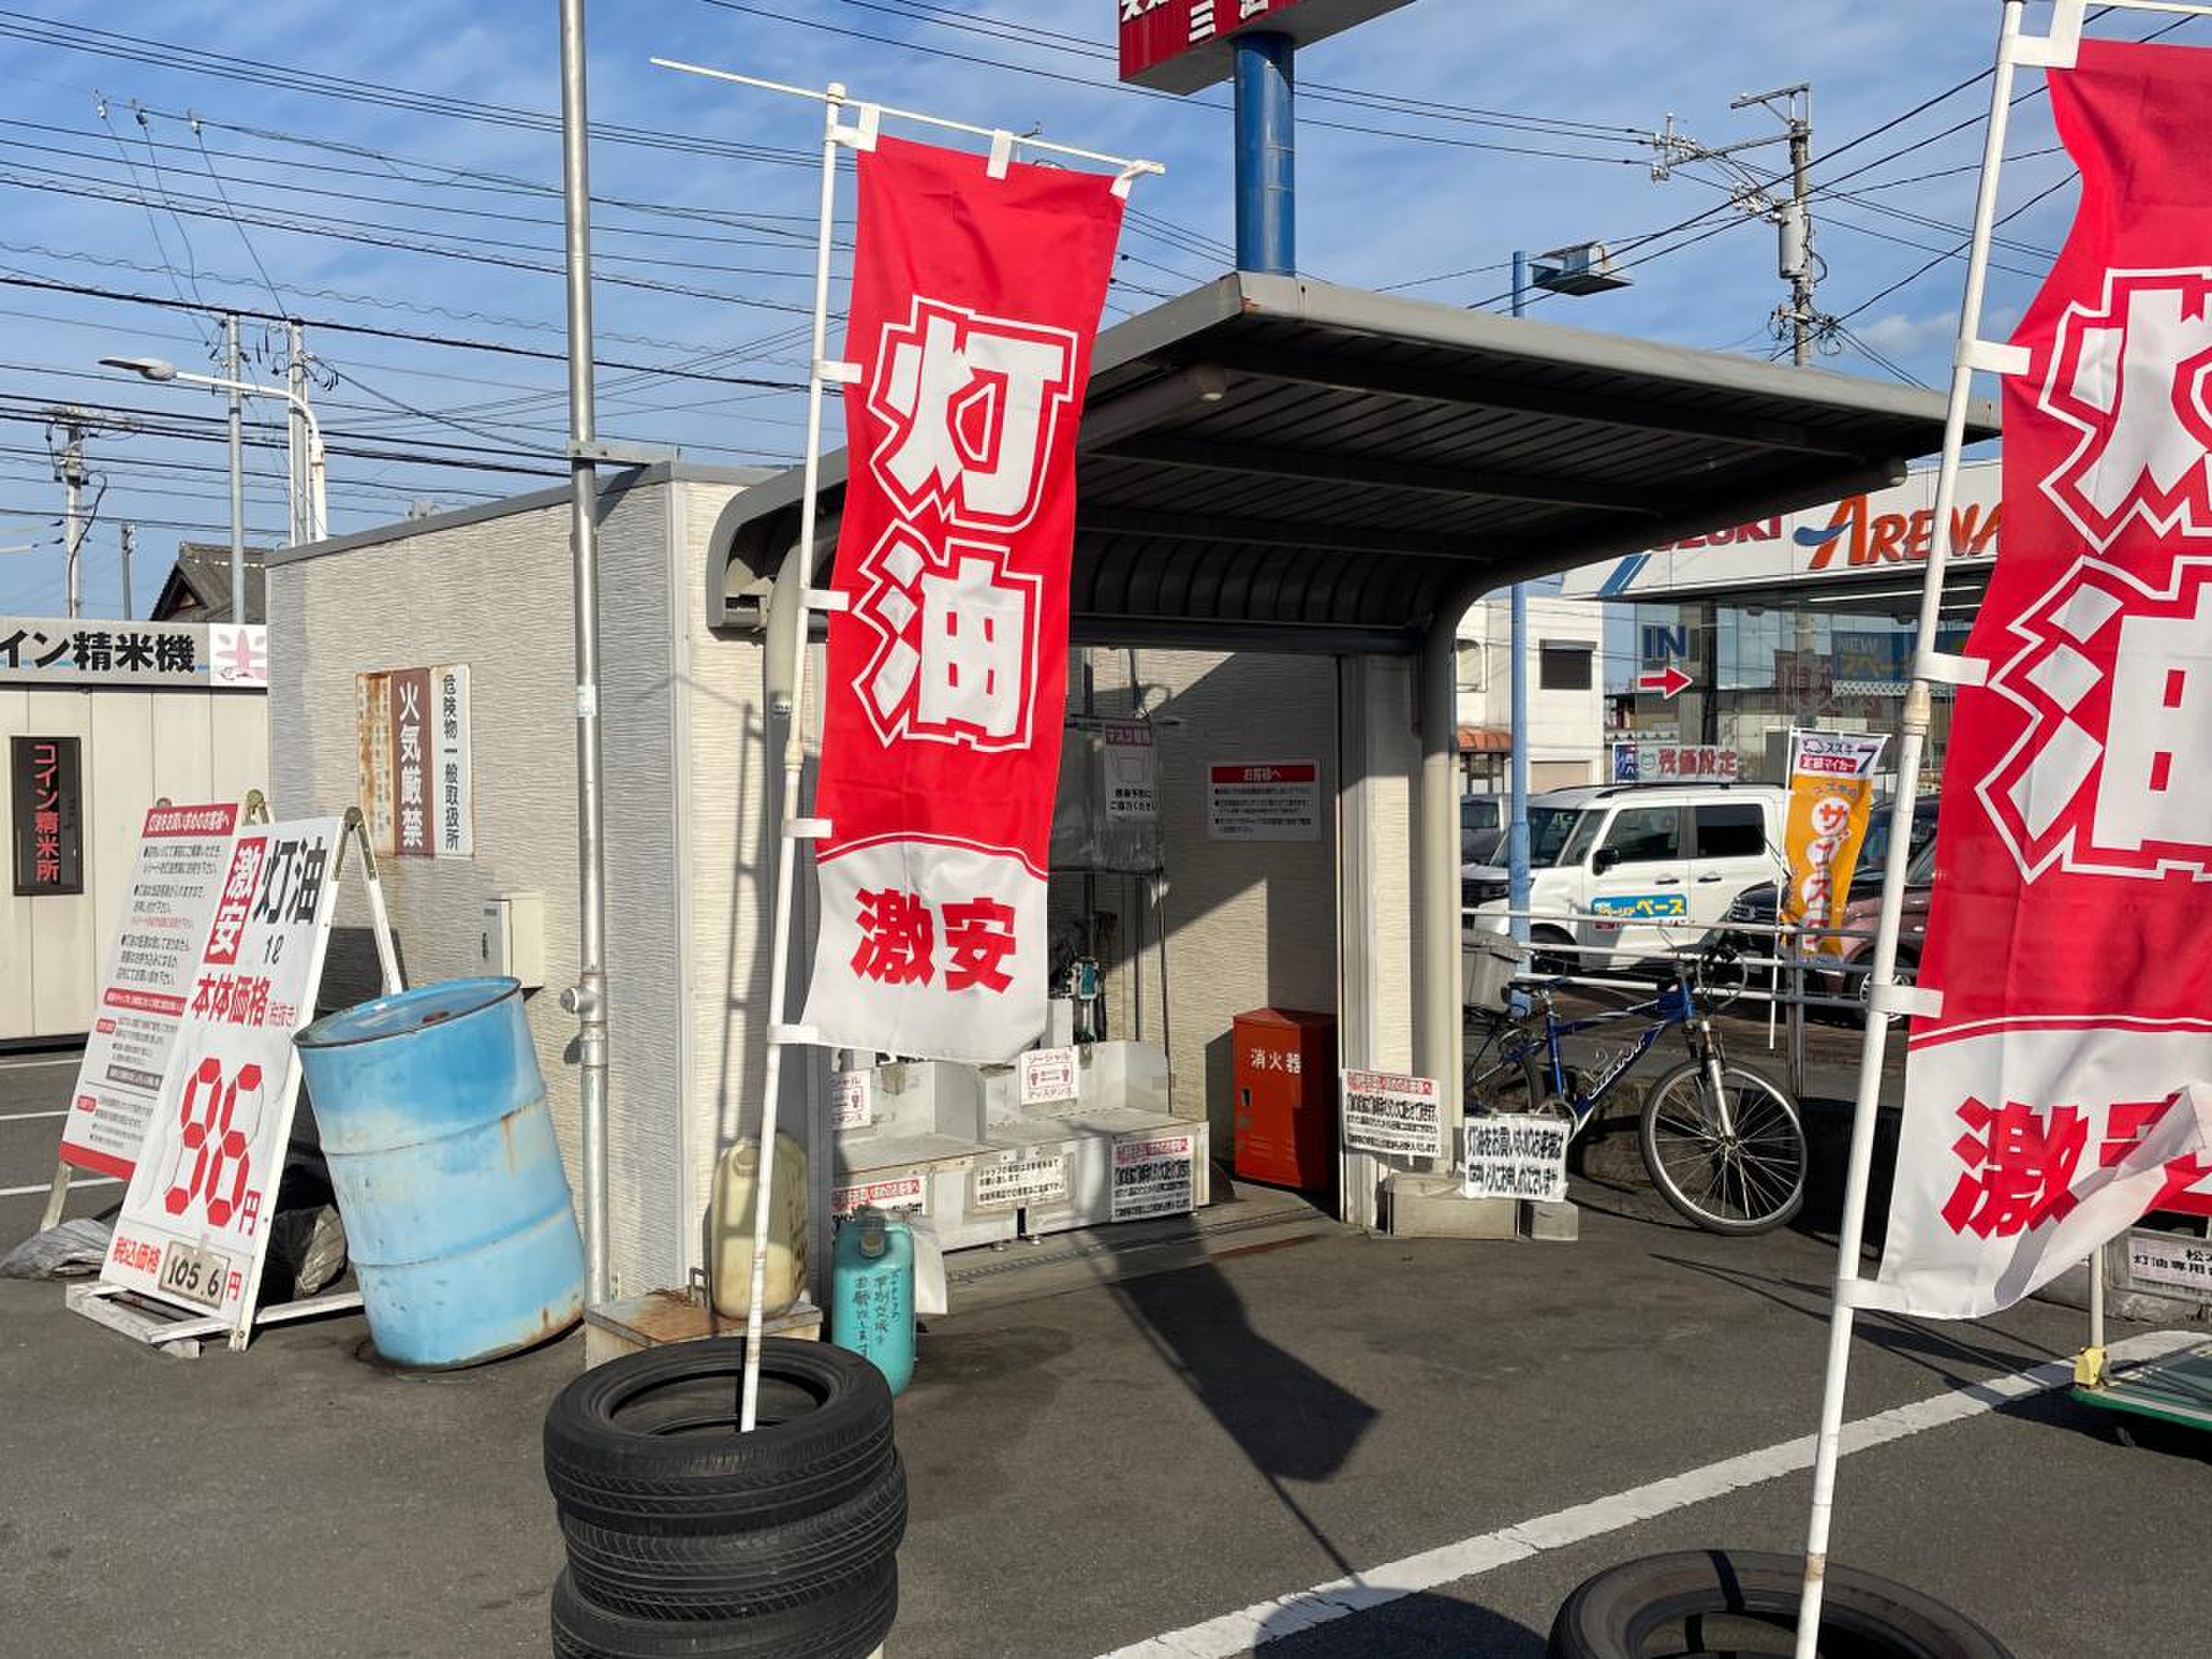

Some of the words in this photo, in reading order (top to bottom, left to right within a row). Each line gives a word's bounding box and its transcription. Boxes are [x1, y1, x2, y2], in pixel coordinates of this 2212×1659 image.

[859, 300, 1072, 745] 灯油
[0, 629, 195, 673] イン精米機
[1641, 625, 1687, 658] IN
[399, 681, 423, 848] 火気厳禁
[442, 674, 460, 851] 危険物一般取扱所
[1857, 742, 1878, 773] 7
[34, 745, 60, 882] コイン精米所
[208, 843, 264, 959] 激安
[253, 836, 327, 925] 灯油
[851, 887, 1016, 994] 激安
[191, 972, 271, 1028] 本体価格
[1251, 1048, 1301, 1074] 消火器
[163, 1057, 263, 1229] 96
[238, 1189, 262, 1236] 円
[112, 1236, 162, 1275] 税込価格
[226, 1270, 242, 1300] 円
